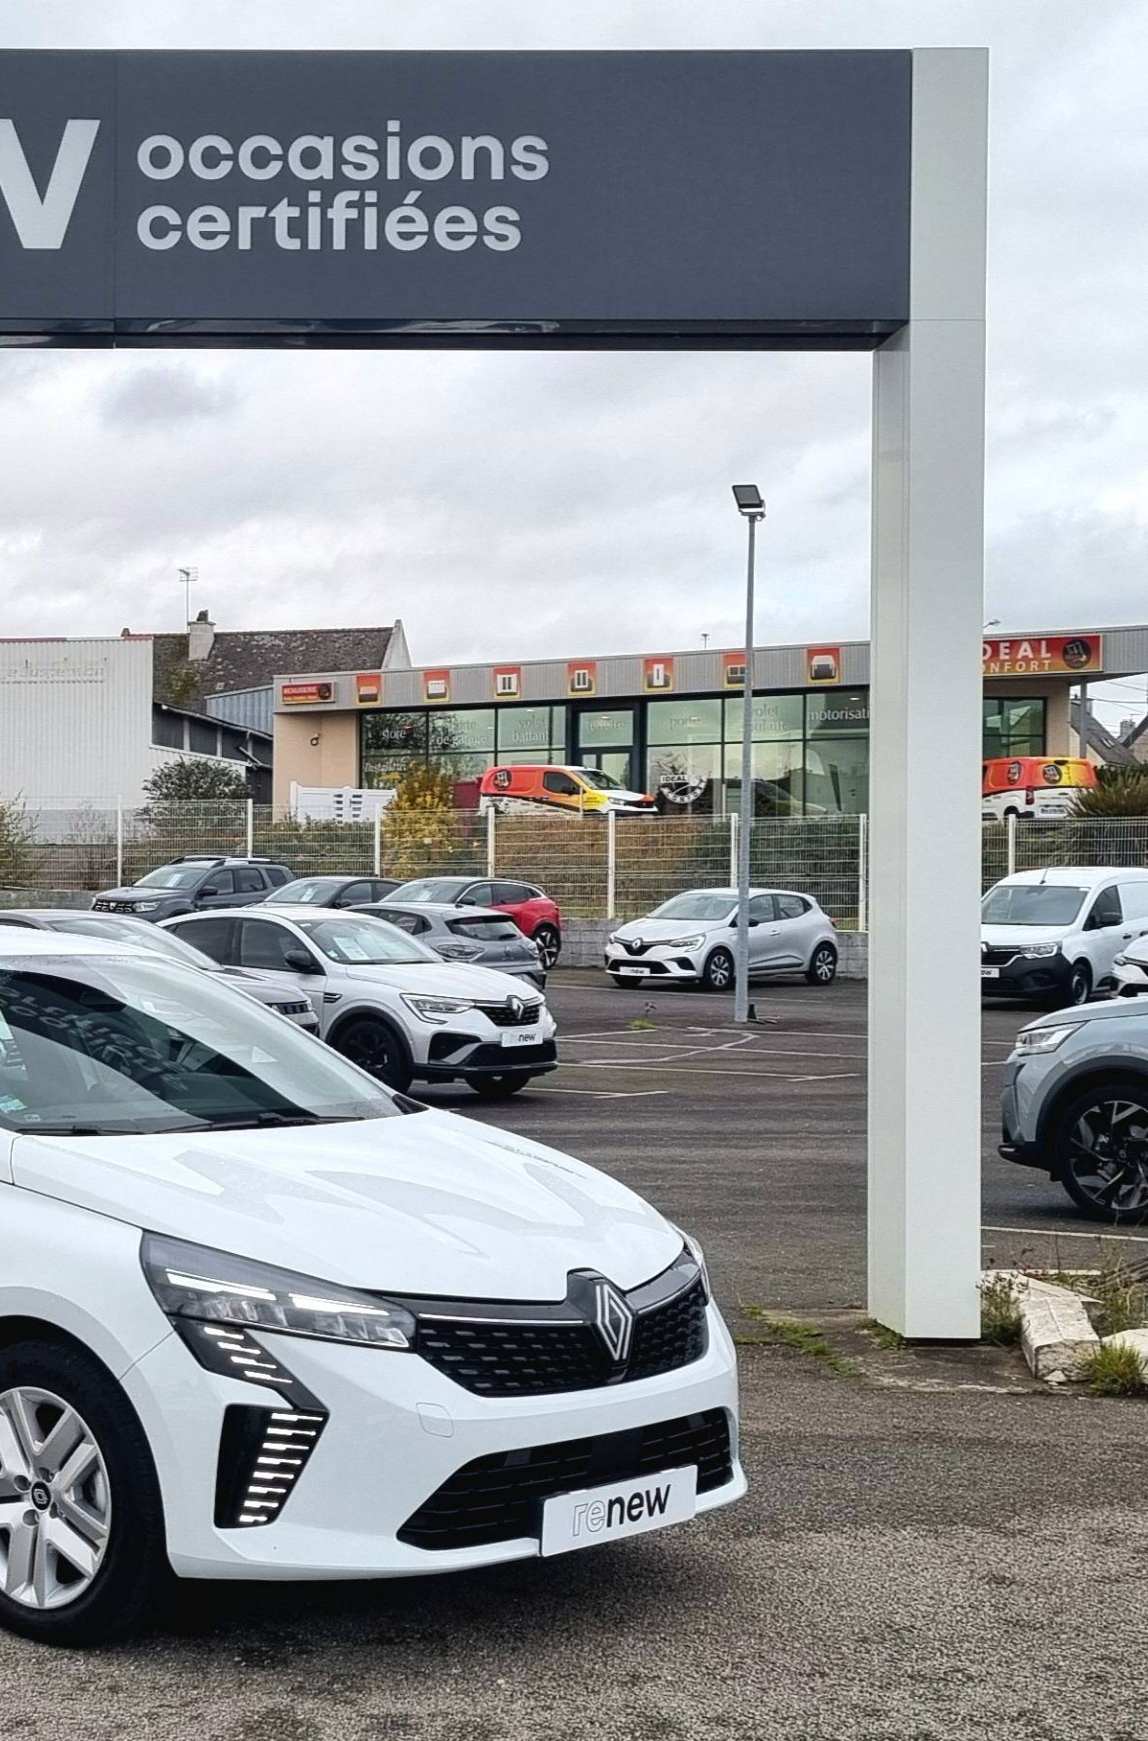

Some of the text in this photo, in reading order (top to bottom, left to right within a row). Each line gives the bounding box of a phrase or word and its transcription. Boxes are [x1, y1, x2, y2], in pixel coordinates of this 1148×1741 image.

[137, 120, 549, 181] occasions
[137, 190, 521, 251] certifiées
[983, 641, 1051, 660] DEAL
[983, 660, 1051, 673] NFORT
[754, 703, 779, 717] olet
[572, 1484, 671, 1537] renew
